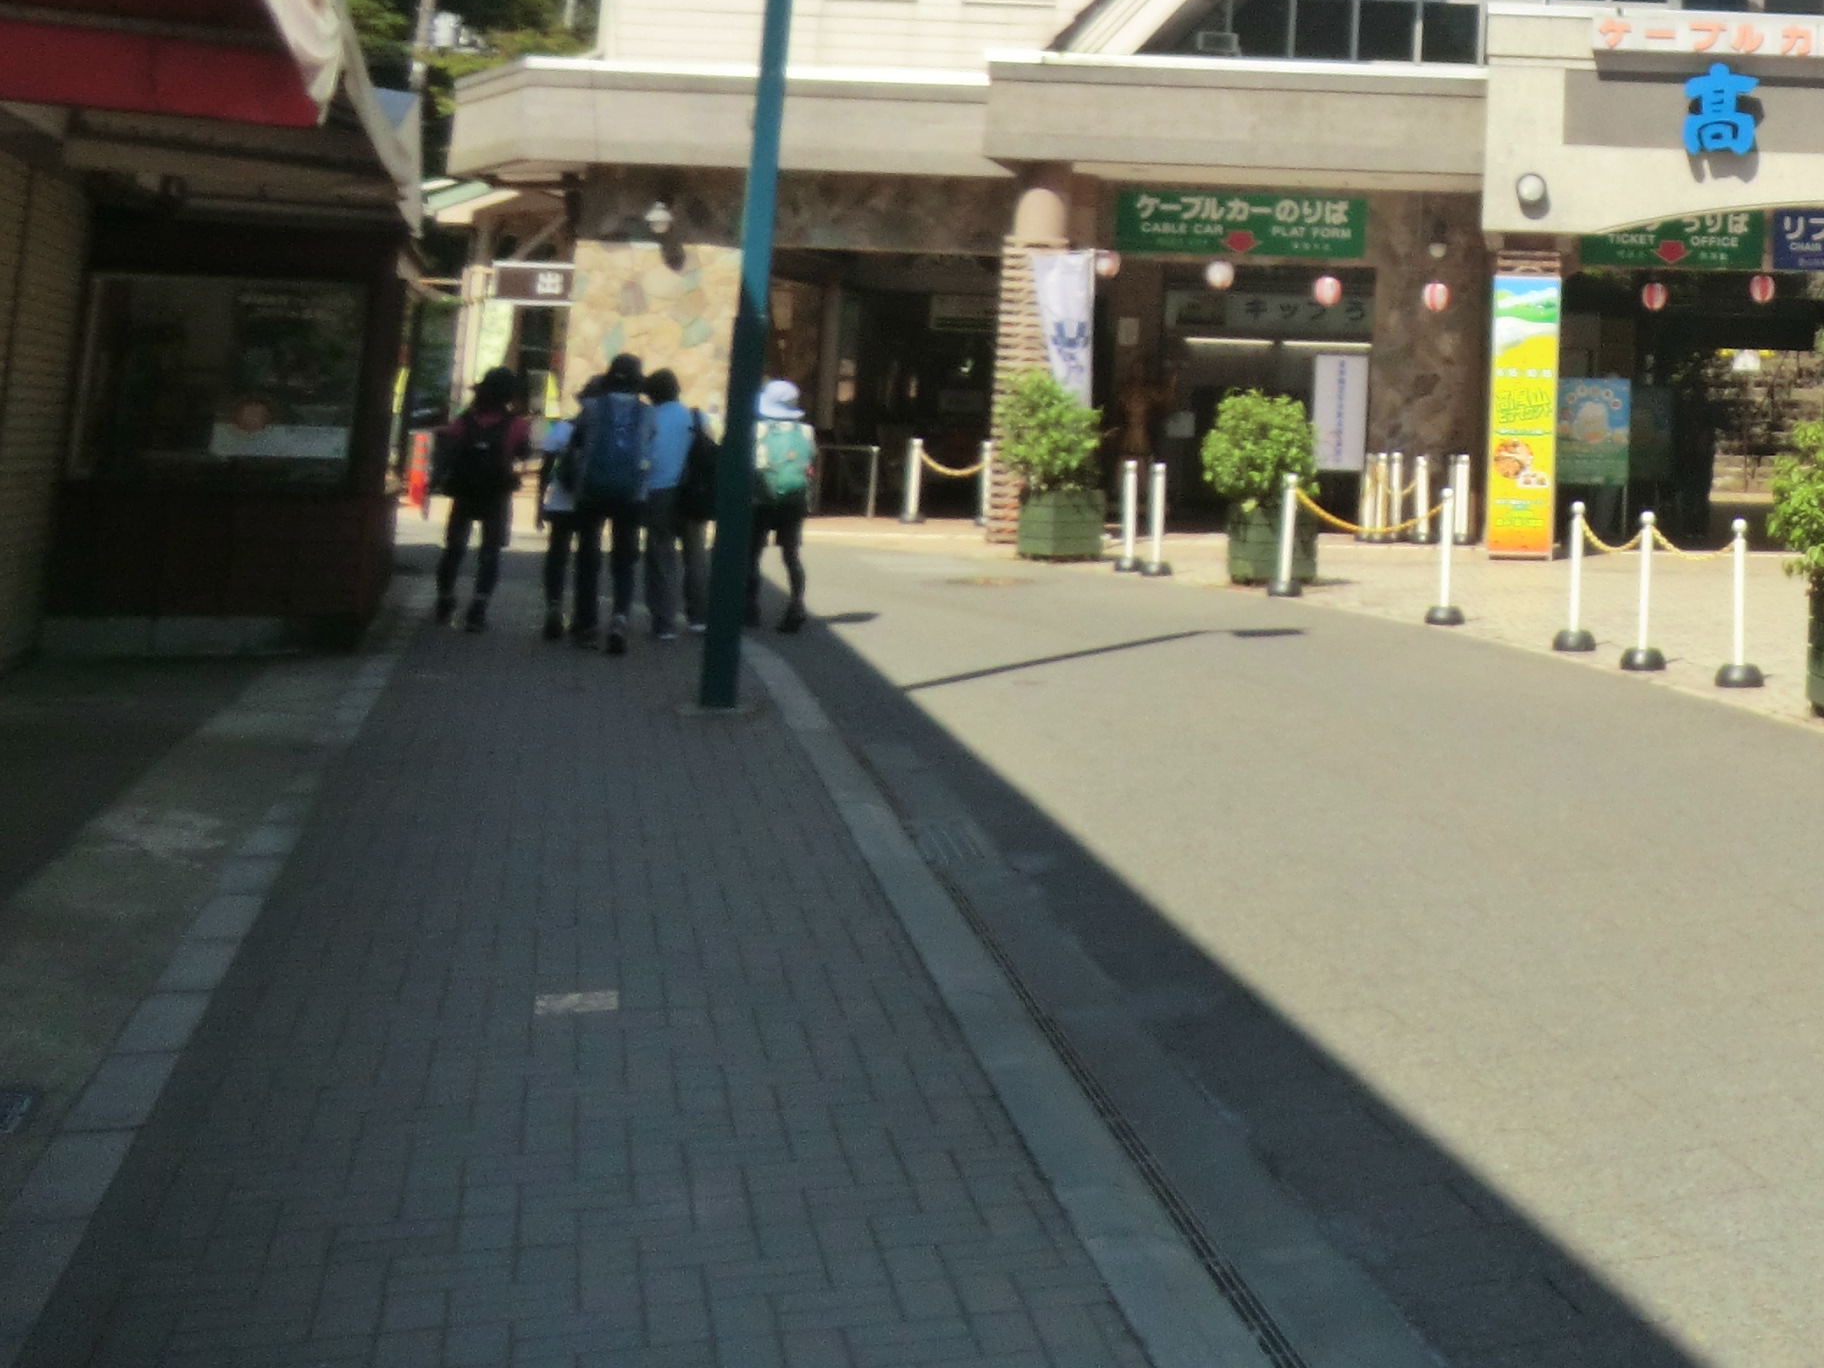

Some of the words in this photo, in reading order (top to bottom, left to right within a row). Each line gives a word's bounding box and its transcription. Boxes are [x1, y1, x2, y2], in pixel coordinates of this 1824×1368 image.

[1135, 194, 1351, 225] ケーブルカーのりば
[1140, 222, 1188, 234] CABLE
[1193, 224, 1224, 235] CAR
[1271, 225, 1306, 238] PLAT
[1311, 227, 1352, 240] FORM
[1607, 233, 1656, 245] TICKET
[1690, 235, 1740, 247] OFFICE
[1789, 241, 1822, 251] CHAIR
